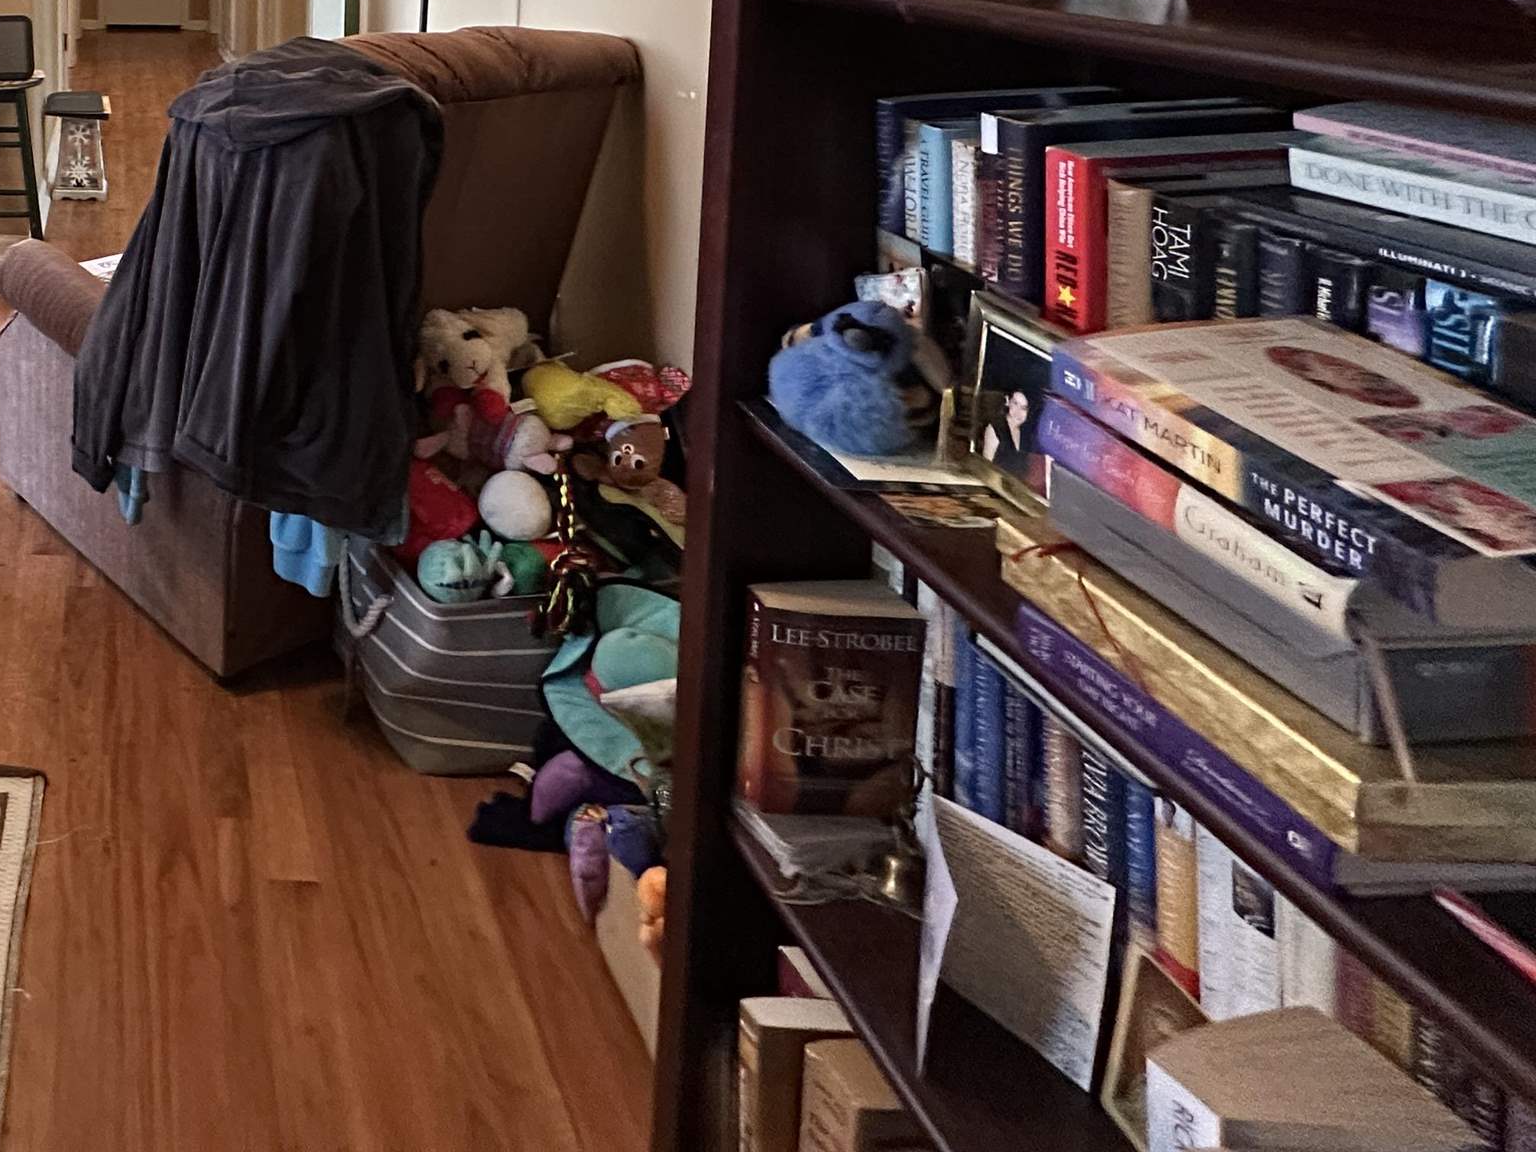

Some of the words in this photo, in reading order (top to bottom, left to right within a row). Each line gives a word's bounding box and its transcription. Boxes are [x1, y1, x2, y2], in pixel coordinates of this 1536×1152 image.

[1007, 147, 1025, 214] THINGS
[1379, 179, 1452, 210] WITH
[1458, 195, 1515, 225] THE
[1007, 221, 1025, 248] WE
[1152, 206, 1169, 281] HOAG
[1168, 224, 1191, 279] TAMI
[1379, 247, 1456, 275] ILLUMINATI
[1144, 417, 1221, 474] MARTIN
[1252, 472, 1278, 496] THE
[1284, 488, 1376, 554] PERFECT
[1264, 498, 1363, 570] MURDER
[771, 623, 812, 646] LEE
[817, 630, 920, 652] STROBEL
